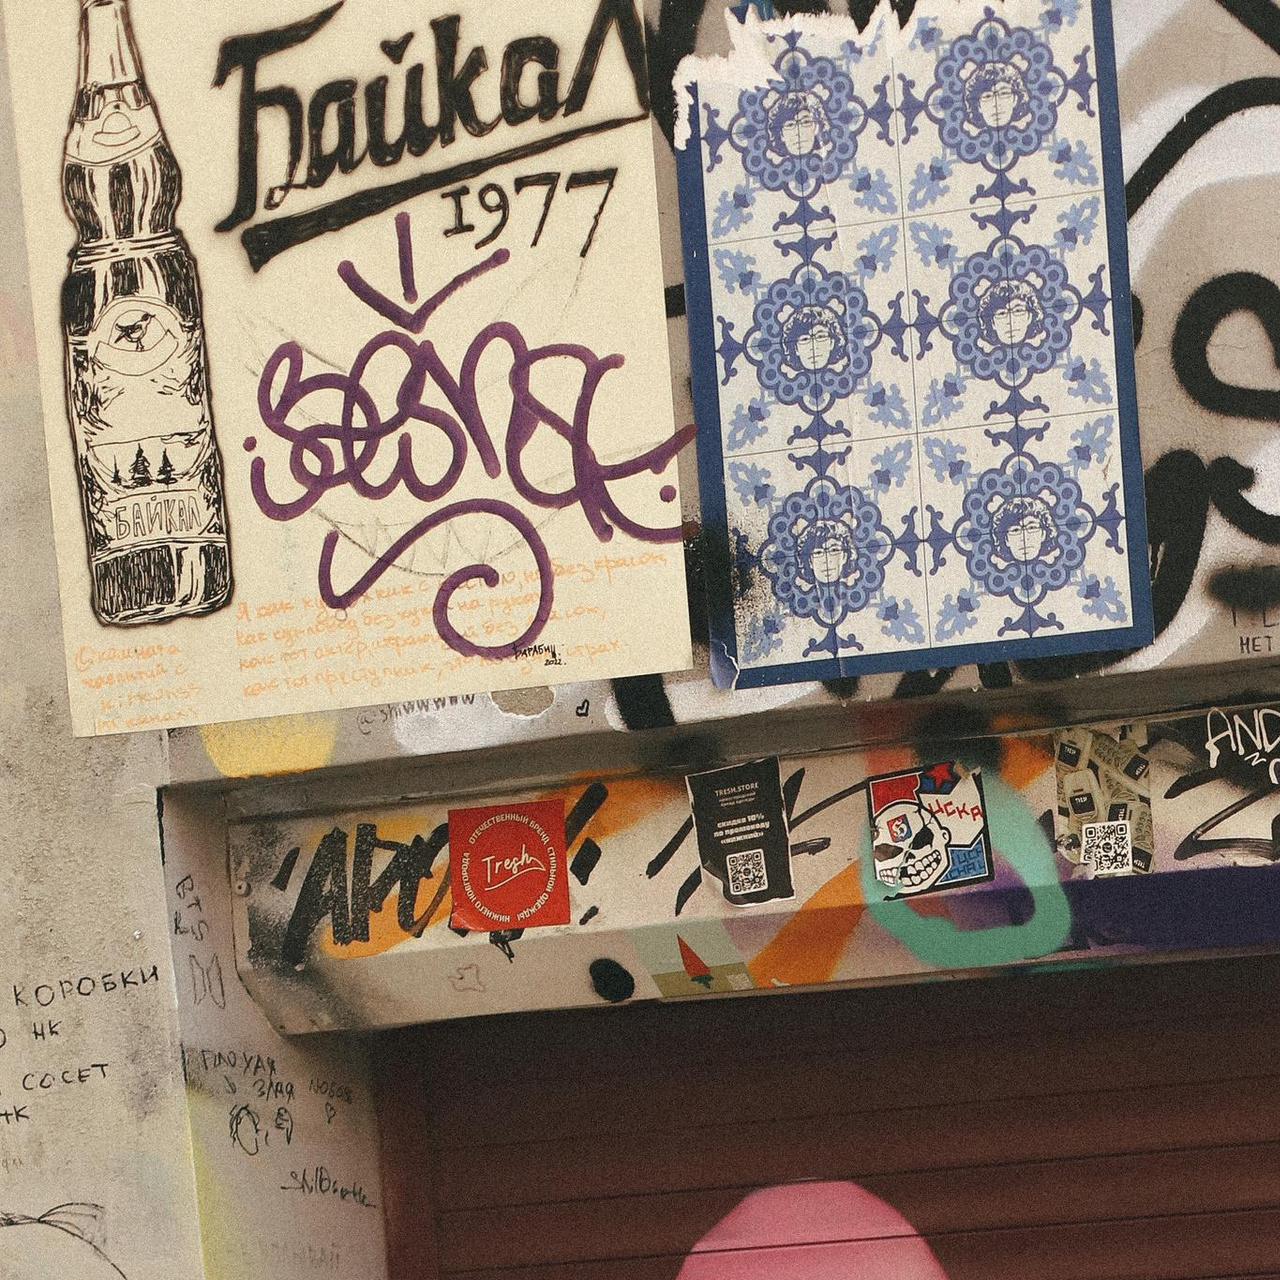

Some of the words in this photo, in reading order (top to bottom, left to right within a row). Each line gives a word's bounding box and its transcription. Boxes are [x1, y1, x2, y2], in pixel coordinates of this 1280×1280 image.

[213, 0, 650, 233] Байкал
[443, 168, 618, 258] 1977
[115, 495, 202, 540] БАЙКАЛ
[1239, 634, 1273, 654] НЕТ
[468, 812, 529, 845] ОТЕЧЕСТВЕННЫЙ
[481, 843, 540, 885] Tresh
[13, 965, 159, 1007] КОРОБКИ
[22, 1063, 110, 1091] СОСЕТ
